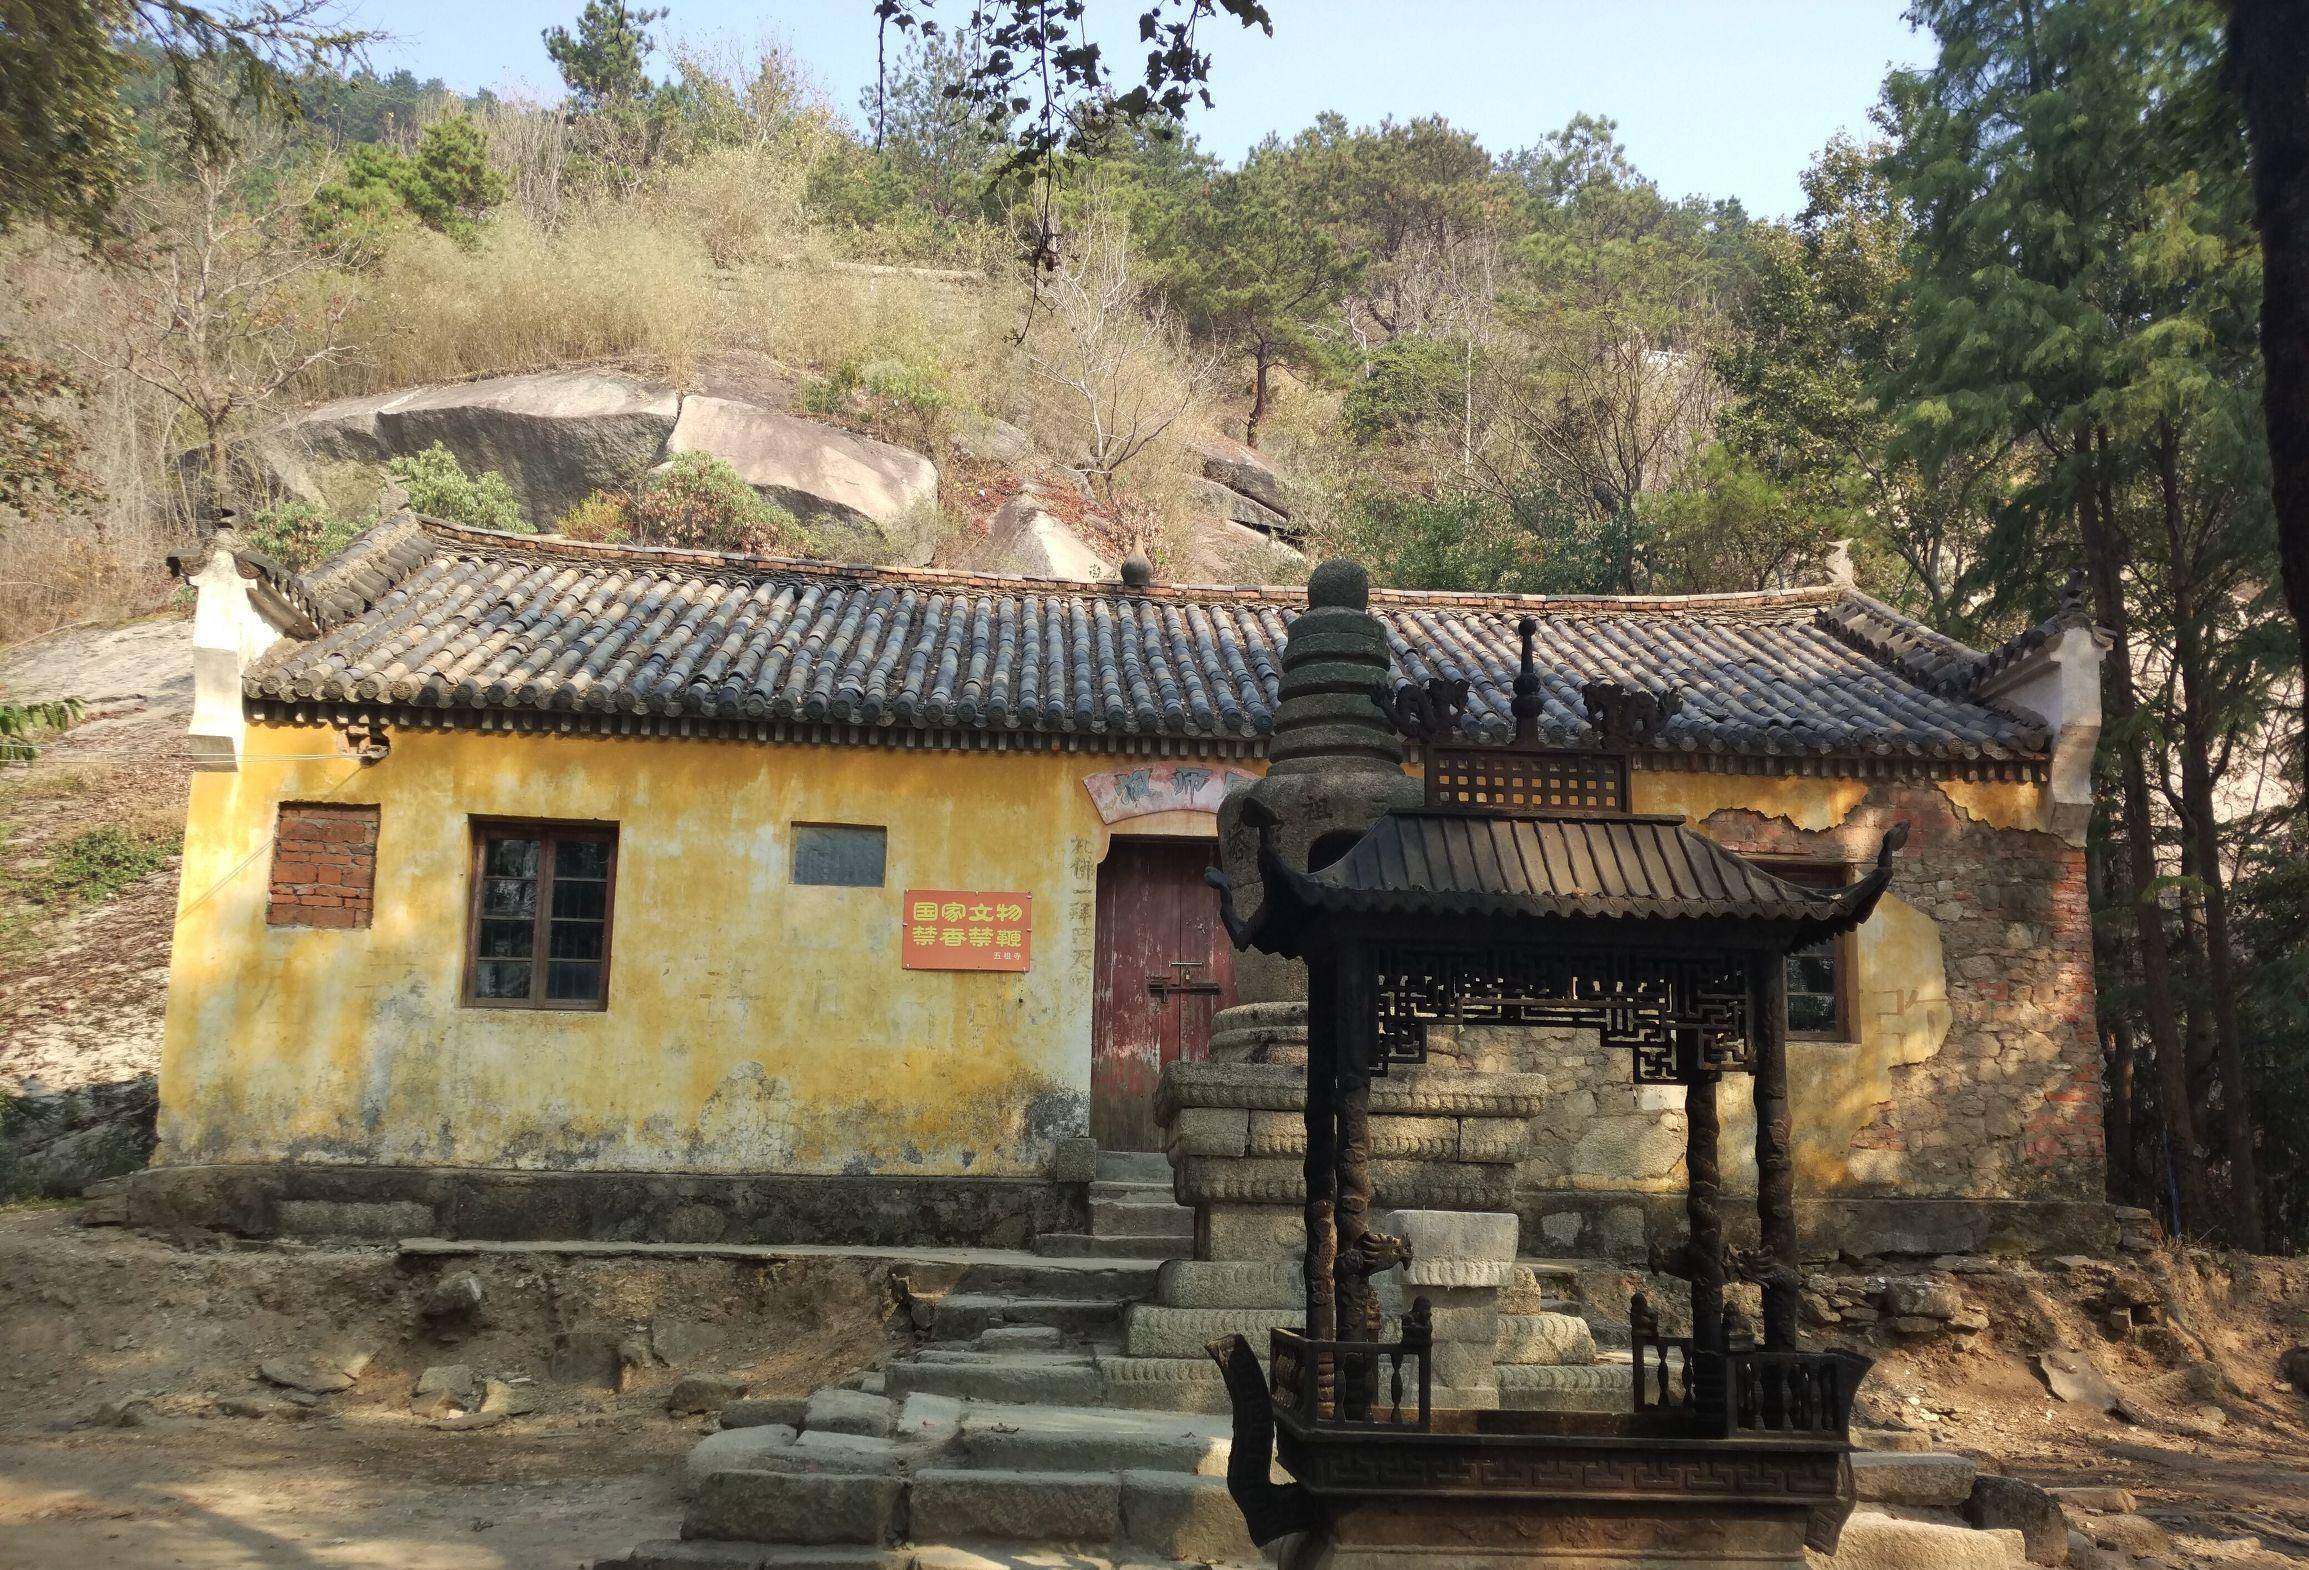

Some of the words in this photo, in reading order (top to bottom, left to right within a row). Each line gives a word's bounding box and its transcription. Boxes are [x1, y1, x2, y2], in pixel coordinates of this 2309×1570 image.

[912, 901, 1024, 923] 国家文物
[911, 925, 1022, 948] 禁香禁鞭
[993, 951, 1022, 961] 五祖寺
